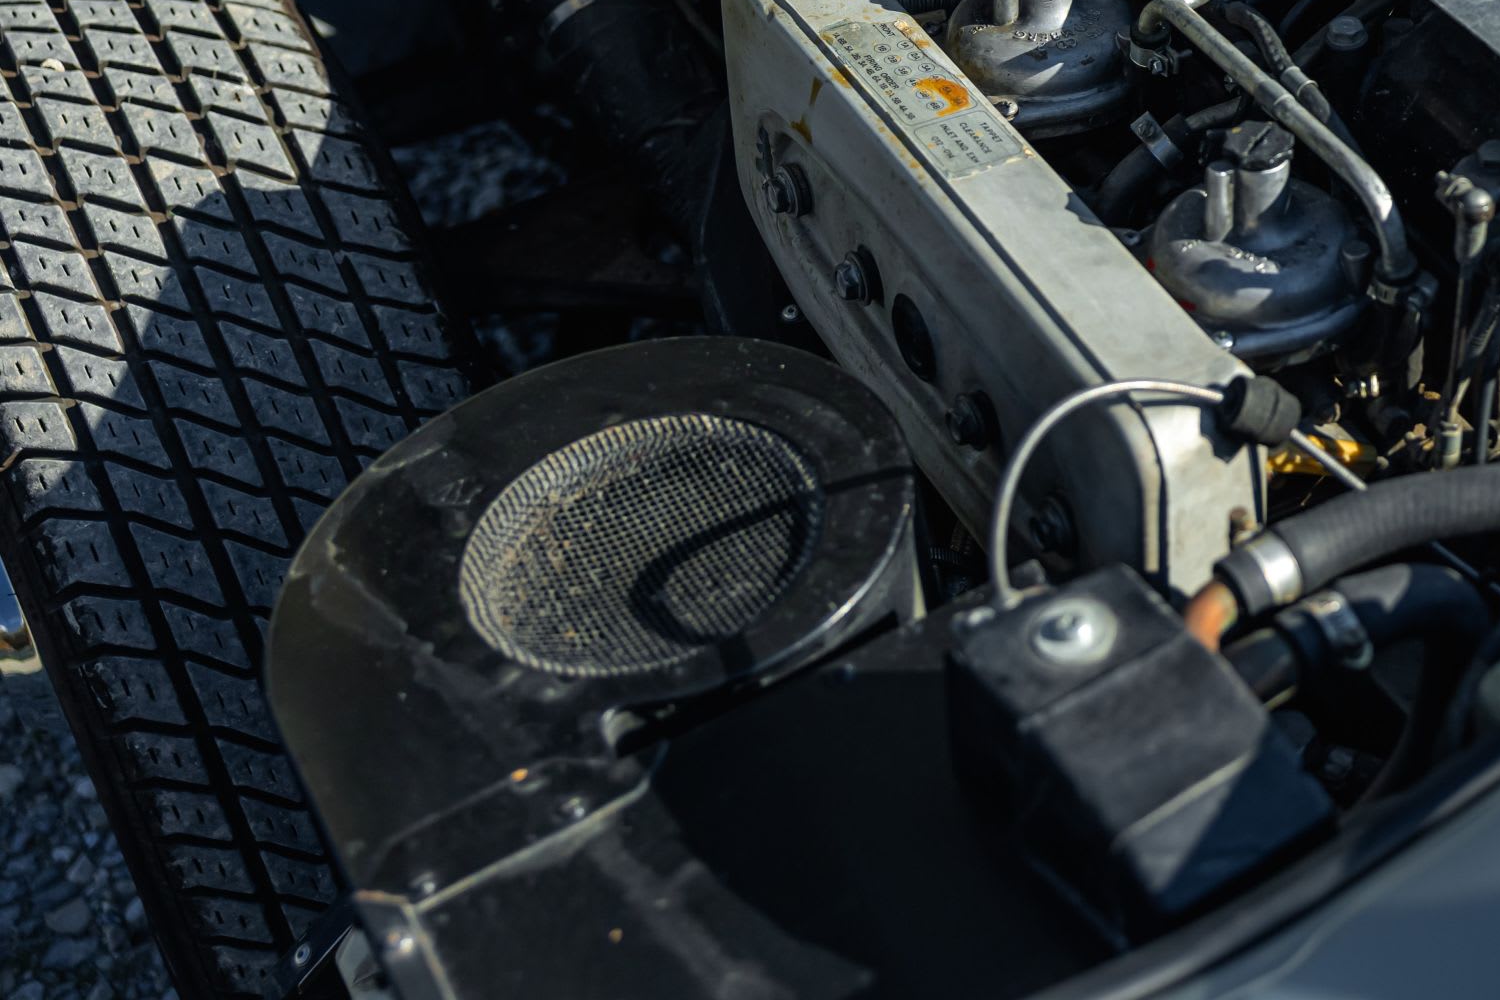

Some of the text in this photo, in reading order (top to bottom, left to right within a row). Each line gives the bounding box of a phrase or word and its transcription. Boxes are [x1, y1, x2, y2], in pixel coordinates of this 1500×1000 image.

[864, 54, 900, 89] FIRING ORDER
[878, 44, 887, 52] 1B
[888, 55, 897, 63] 2B
[899, 67, 908, 75] 3B
[931, 101, 940, 109] 6B
[940, 122, 980, 164] INLET AND EXH
[959, 121, 993, 154] CLEARANCE
[980, 121, 1003, 143] TAPPET
